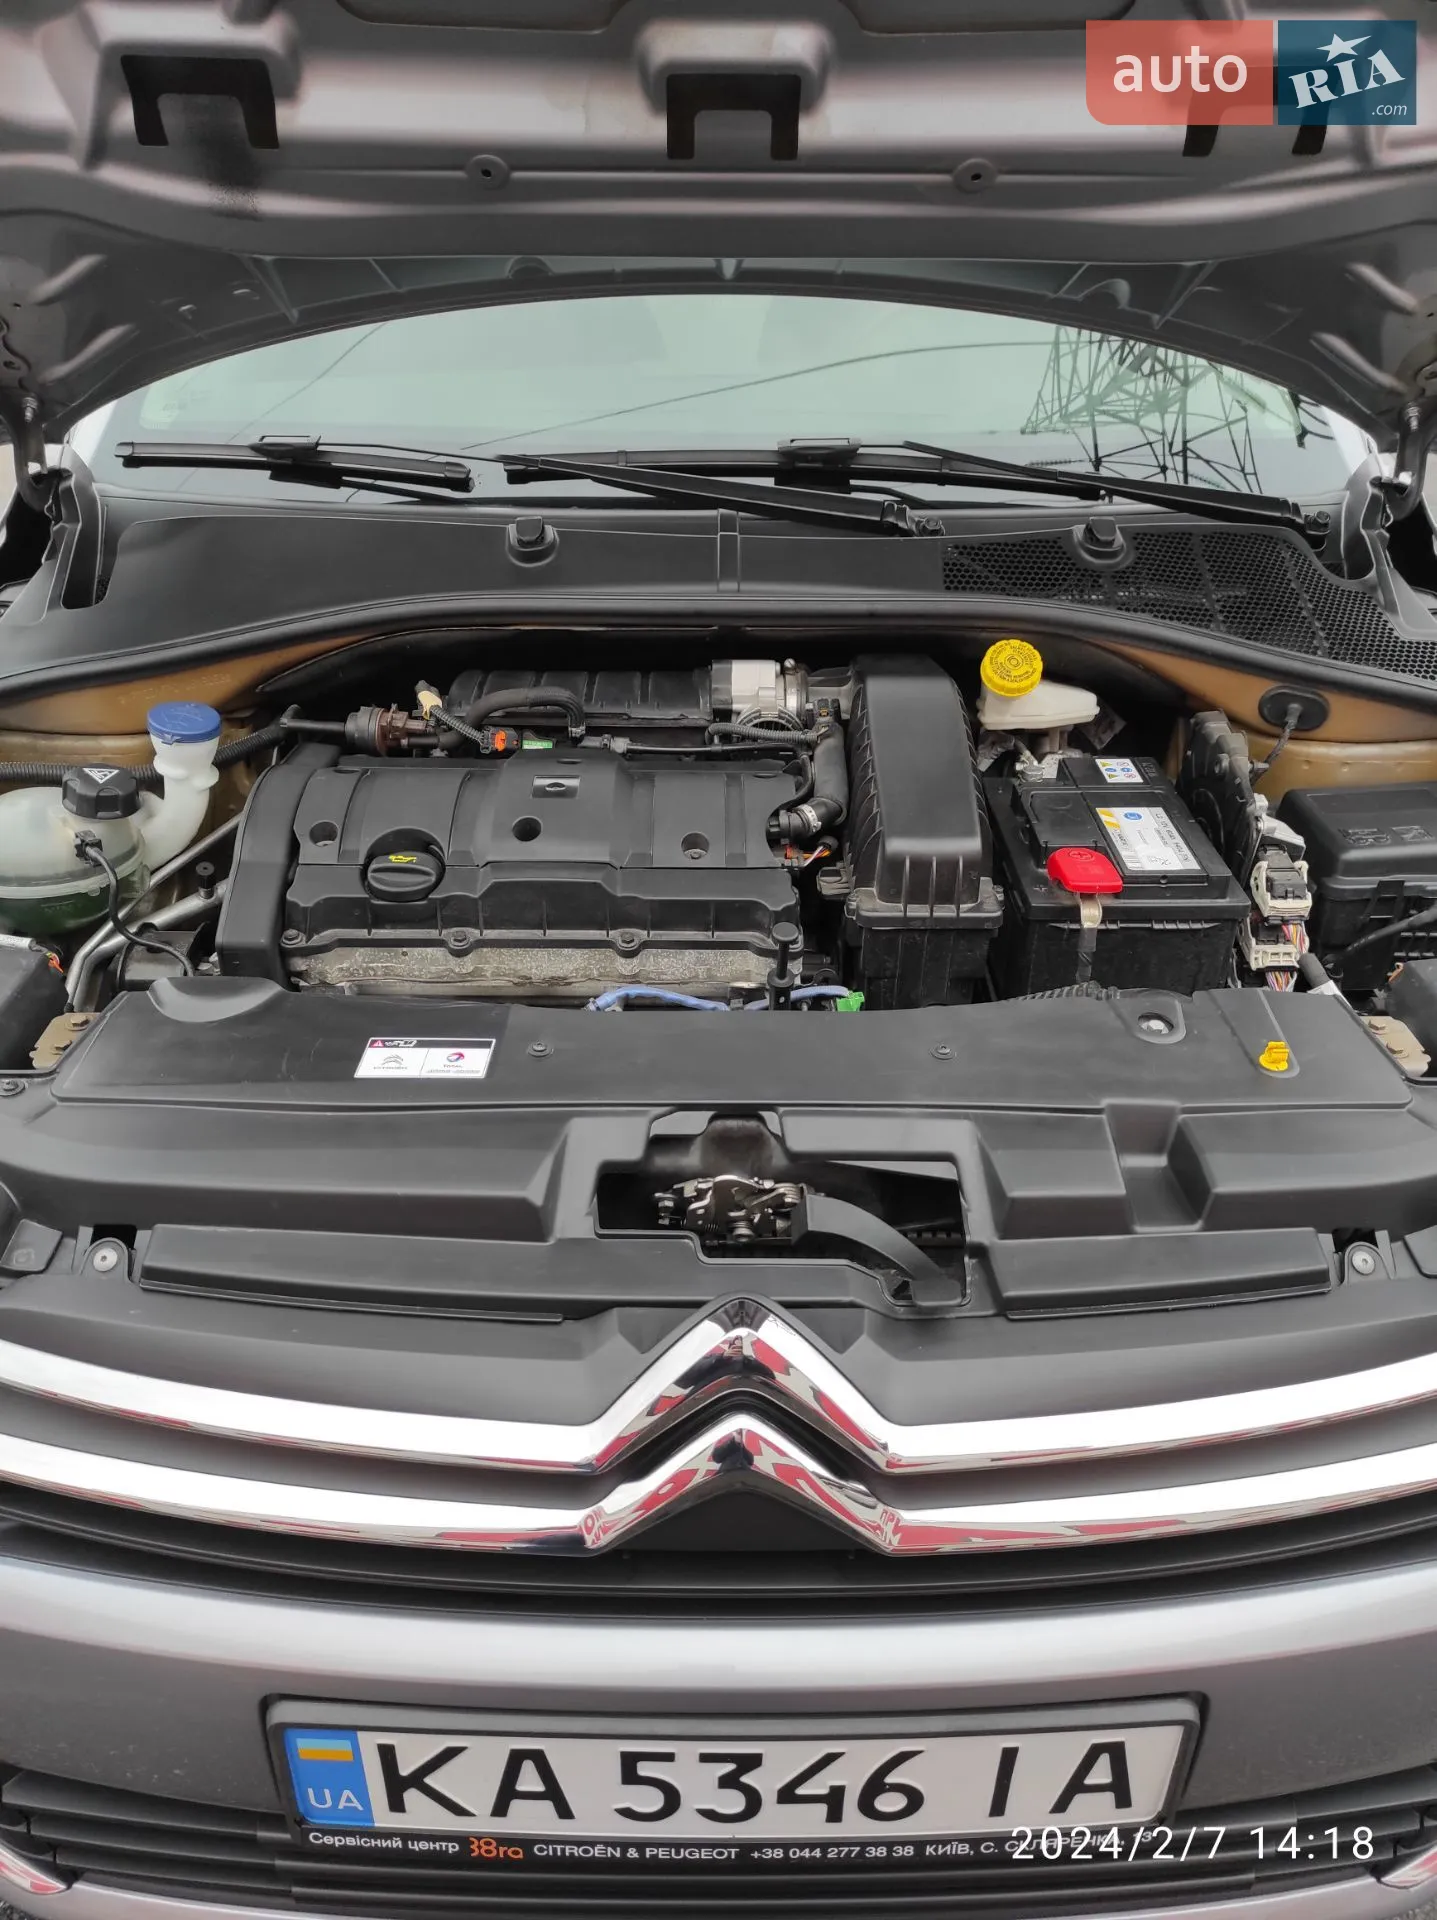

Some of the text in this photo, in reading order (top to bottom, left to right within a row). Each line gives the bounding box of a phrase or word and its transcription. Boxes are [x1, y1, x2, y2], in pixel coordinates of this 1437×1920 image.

[376, 1741, 1133, 1823] KA 5346 IA
[307, 1787, 364, 1811] UA
[308, 1832, 402, 1849] Сервісний
[408, 1839, 460, 1853] центр
[534, 1844, 621, 1859] CITROËN
[626, 1847, 640, 1859] &
[645, 1848, 740, 1860] PEUGEOT
[750, 1848, 784, 1858] +38
[789, 1848, 822, 1858] 044
[827, 1847, 860, 1858] 277
[865, 1846, 887, 1857] 38
[892, 1845, 914, 1857] 38
